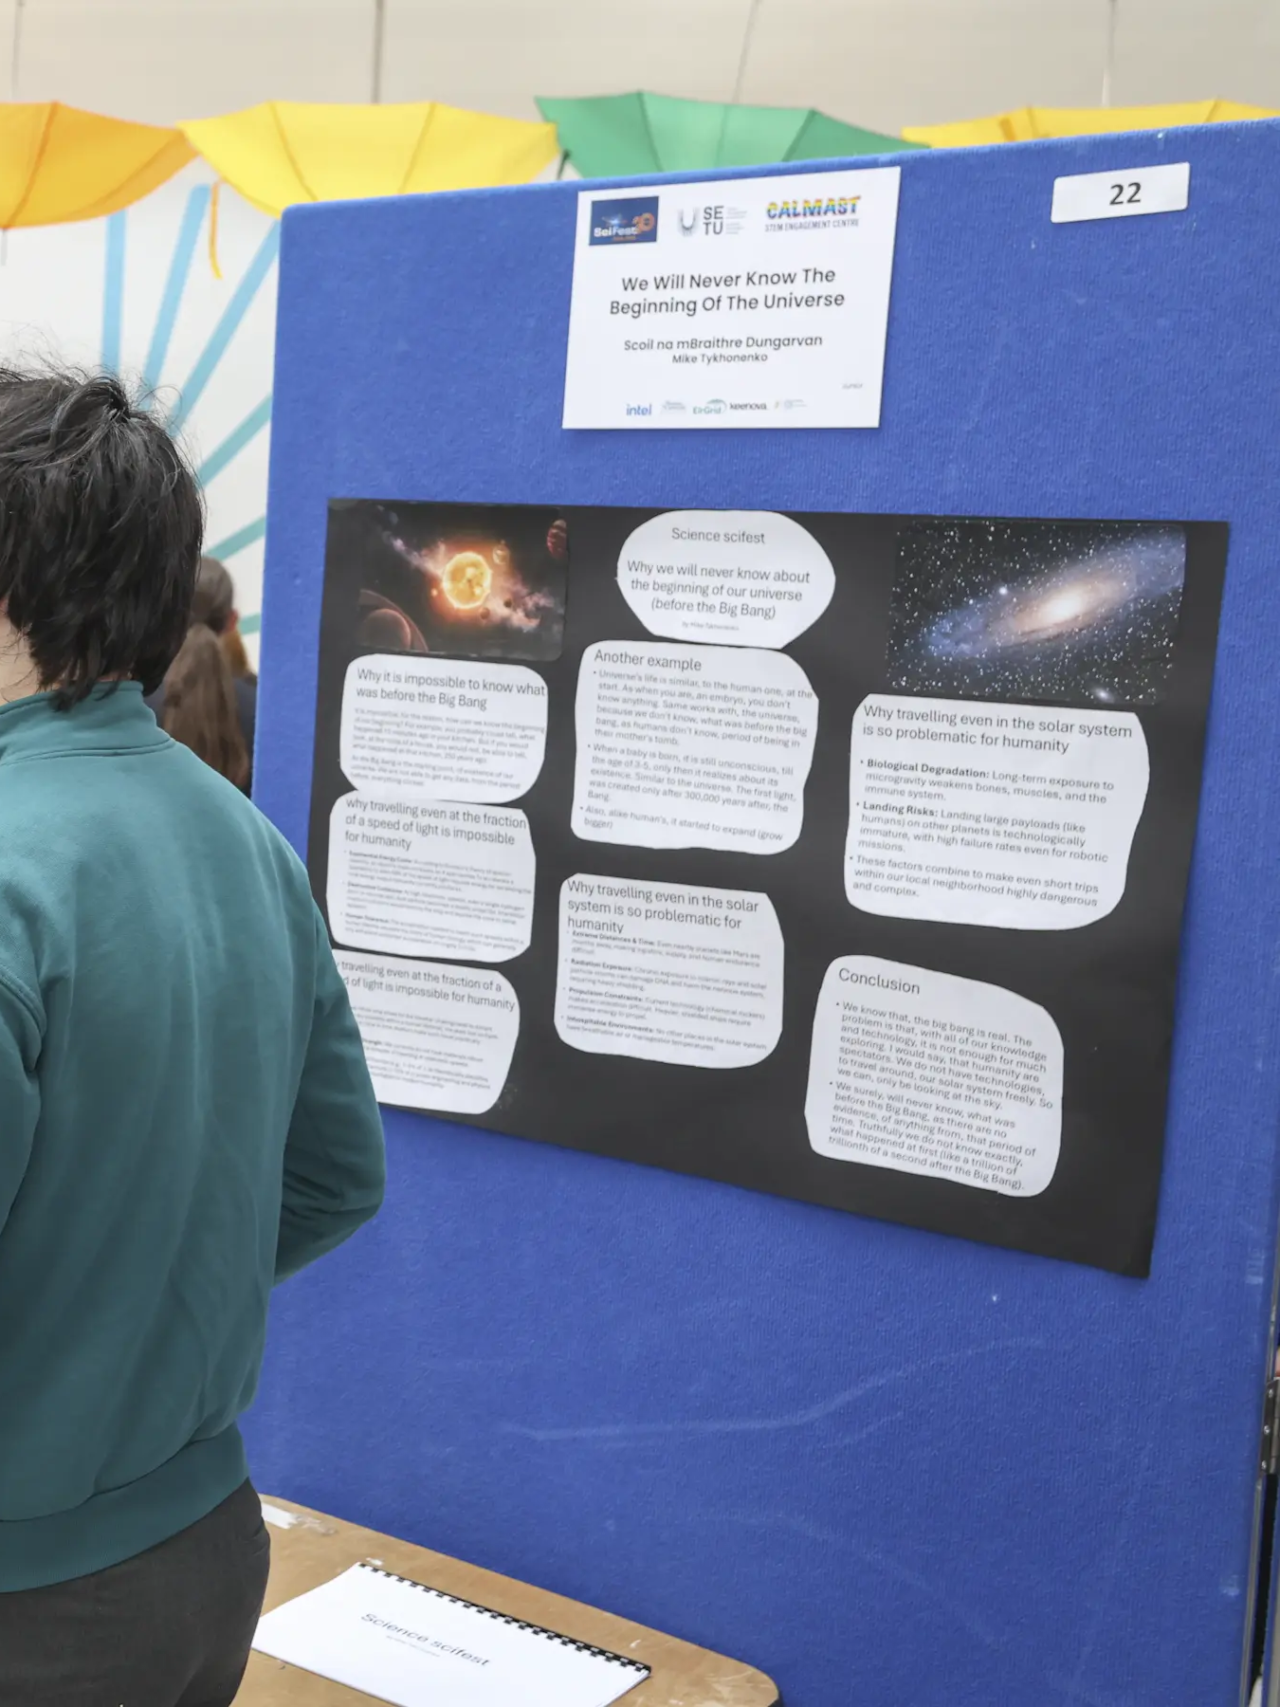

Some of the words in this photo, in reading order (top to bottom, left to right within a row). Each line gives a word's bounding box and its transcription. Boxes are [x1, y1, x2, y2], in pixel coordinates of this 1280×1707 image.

[1109, 182, 1141, 205] 22
[703, 205, 724, 220] SE
[766, 196, 861, 219] CALMAST
[703, 221, 724, 235] TU
[785, 220, 831, 231] ENGAGEMENT
[832, 218, 859, 229] CENTRE
[622, 277, 648, 291] We
[653, 273, 684, 290] Will
[689, 274, 741, 288] Never
[746, 271, 797, 286] Know
[802, 268, 835, 283] The
[610, 296, 697, 319] Beginning
[702, 295, 722, 311] Of
[726, 294, 758, 310] The
[764, 292, 845, 309] Universe
[624, 338, 654, 351] Scoil
[656, 340, 673, 350] na
[676, 336, 742, 349] mBraithre
[745, 336, 822, 351] Dungarvan
[672, 353, 697, 363] Mike
[701, 352, 768, 365] Tykhonenko
[626, 403, 652, 416] intel
[671, 527, 720, 542] Science
[723, 530, 765, 544] scifest
[627, 560, 654, 576] Why
[656, 564, 674, 574] we
[676, 563, 697, 576] will
[700, 567, 734, 578] never
[737, 566, 771, 581] know
[773, 569, 810, 583] about
[631, 578, 650, 591] the
[652, 579, 709, 597] beginning
[711, 583, 724, 595] of
[726, 586, 747, 597] our
[749, 586, 802, 601] universe
[651, 597, 694, 612] (before
[696, 600, 716, 613] the
[719, 601, 738, 618] Big
[740, 603, 776, 620] Bang)
[594, 649, 644, 665] Another
[647, 656, 701, 672] example
[357, 667, 382, 684] Why
[383, 671, 391, 682] it
[392, 673, 402, 683] is
[404, 674, 466, 688] impossible
[468, 679, 480, 690] to
[482, 679, 514, 693] know
[516, 683, 545, 696] what
[356, 687, 378, 698] was
[380, 687, 416, 702] before
[417, 691, 436, 704] the
[438, 691, 456, 708] Big
[458, 693, 487, 712] Bang
[863, 704, 893, 721] Why
[896, 708, 957, 727] travelling
[960, 715, 992, 727] even
[996, 715, 1008, 728] in
[1012, 716, 1035, 730] the
[1038, 719, 1075, 733] solar
[1078, 724, 1132, 738] system
[863, 723, 873, 735] is
[877, 726, 892, 737] so
[896, 727, 976, 744] problematic
[980, 732, 999, 746] for
[1002, 734, 1069, 755] humanity
[867, 758, 918, 772] Biological
[920, 763, 989, 778] Degradation:
[992, 770, 1046, 784] Long-term
[1049, 778, 1100, 789] exposure
[1102, 781, 1114, 790] to
[865, 773, 926, 787] microgravity
[928, 779, 973, 790] weakens
[975, 782, 1010, 796] bones,
[1013, 787, 1062, 800] muscles,
[1064, 792, 1086, 802] and
[1088, 793, 1107, 804] the
[346, 797, 368, 812] why
[369, 800, 418, 819] travelling
[420, 807, 447, 819] even
[449, 810, 459, 821] at
[462, 810, 481, 823] the
[484, 814, 526, 830] fraction
[862, 800, 904, 815] Landing
[906, 805, 938, 817] Risks:
[940, 809, 981, 823] Landing
[983, 813, 1009, 826] large
[1011, 818, 1060, 830] payloads
[1062, 822, 1085, 833] (like
[345, 813, 356, 825] of
[358, 816, 365, 826] a
[367, 817, 400, 831] speed
[402, 820, 413, 832] of
[415, 821, 438, 837] light
[440, 826, 451, 837] is
[453, 826, 515, 845] impossible
[345, 830, 360, 842] for
[362, 832, 412, 851] humanity
[567, 880, 594, 896] Why
[597, 884, 652, 904] travelling
[655, 891, 685, 904] even
[688, 892, 699, 905] in
[701, 895, 723, 909] the
[726, 898, 758, 912] solar
[568, 900, 611, 914] system
[614, 904, 624, 915] is
[627, 906, 642, 917] so
[644, 907, 721, 927] problematic
[723, 914, 742, 929] for
[568, 916, 624, 934] humanity
[342, 960, 384, 977] travelling
[386, 968, 410, 979] even
[411, 971, 421, 980] at
[423, 971, 439, 983] the
[441, 973, 481, 989] fraction
[482, 980, 493, 990] of
[495, 983, 501, 992] a
[838, 967, 920, 994] Conclusion
[351, 976, 361, 987] of
[362, 977, 383, 991] light
[385, 982, 393, 992] is
[395, 984, 449, 1001] impossible
[451, 990, 465, 1002] for
[467, 994, 516, 1012] humanity
[361, 1613, 429, 1642] Science
[430, 1640, 489, 1666] scifest
